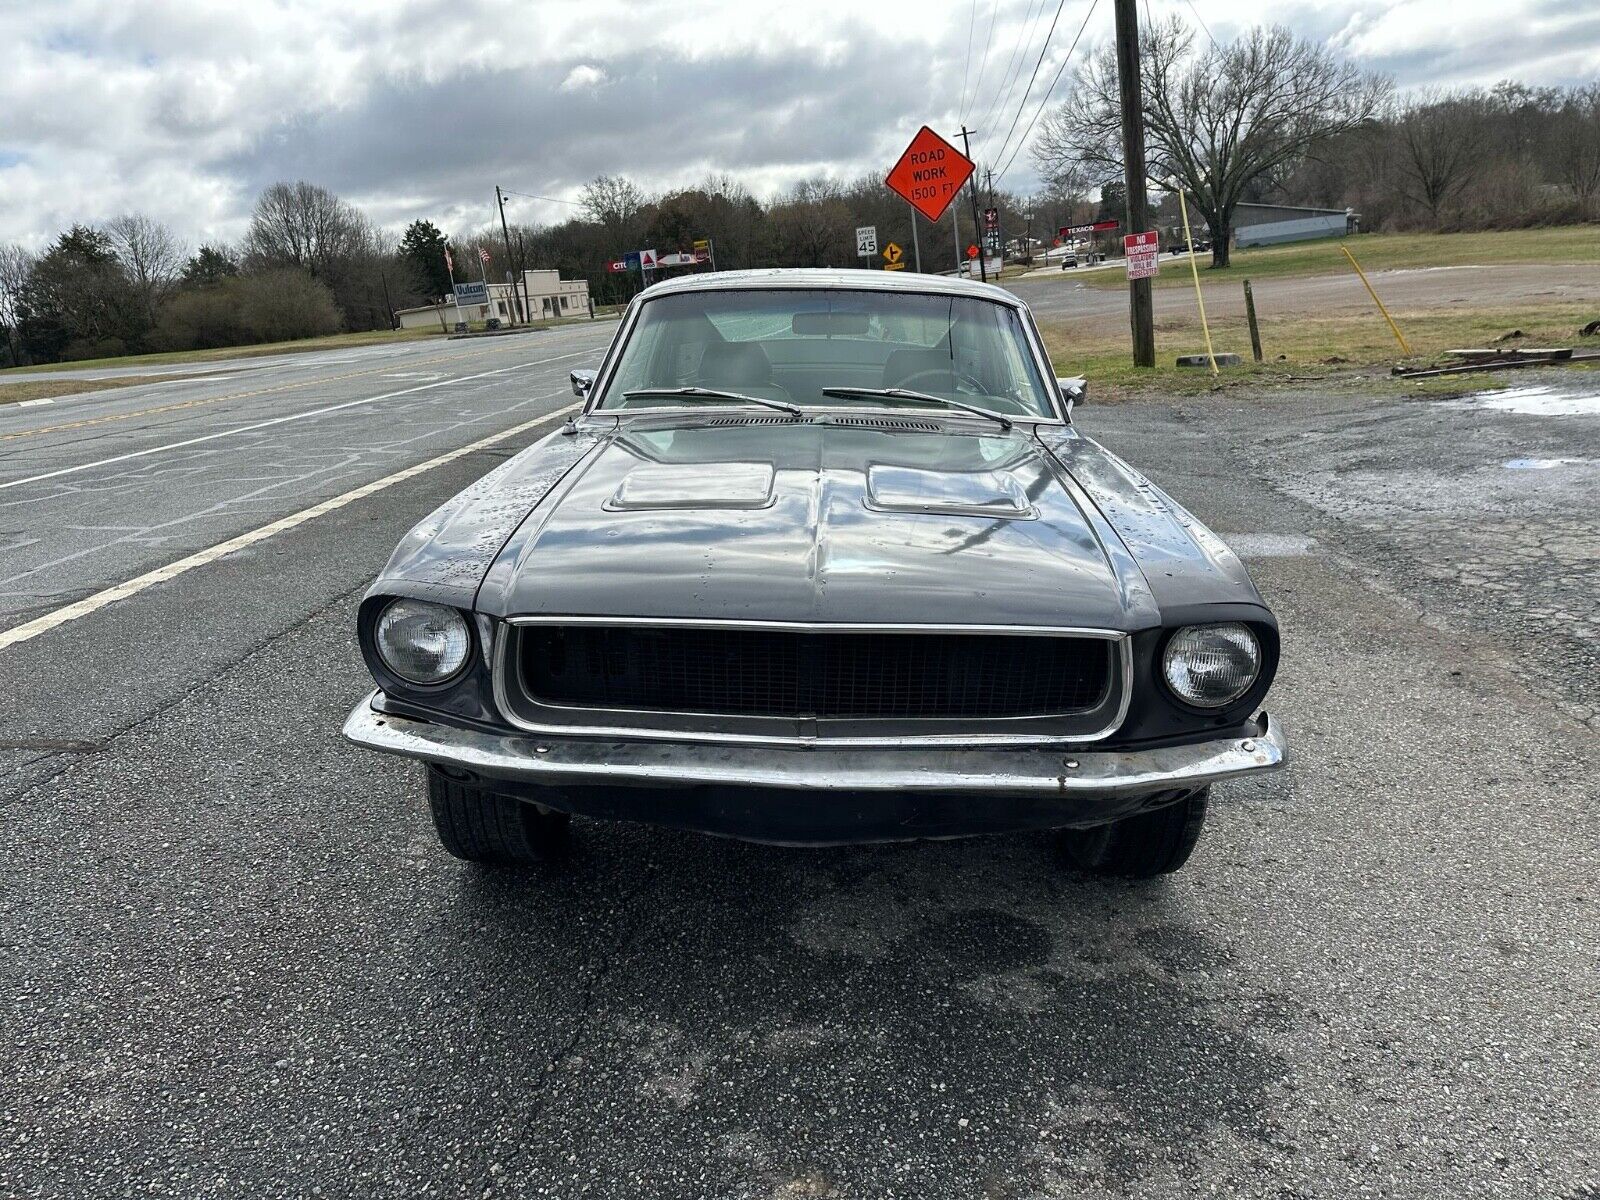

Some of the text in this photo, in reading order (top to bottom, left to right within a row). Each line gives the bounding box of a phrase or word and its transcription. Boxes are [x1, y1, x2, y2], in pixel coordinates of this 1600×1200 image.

[911, 149, 945, 165] ROAD
[913, 166, 947, 183] WORK
[911, 182, 954, 200] 1500 FT
[1067, 225, 1094, 234] TEXACO
[1136, 234, 1146, 245] NO
[859, 241, 876, 252] 45
[1127, 242, 1157, 255] TRESPASSING
[456, 284, 484, 295] Vulcan
